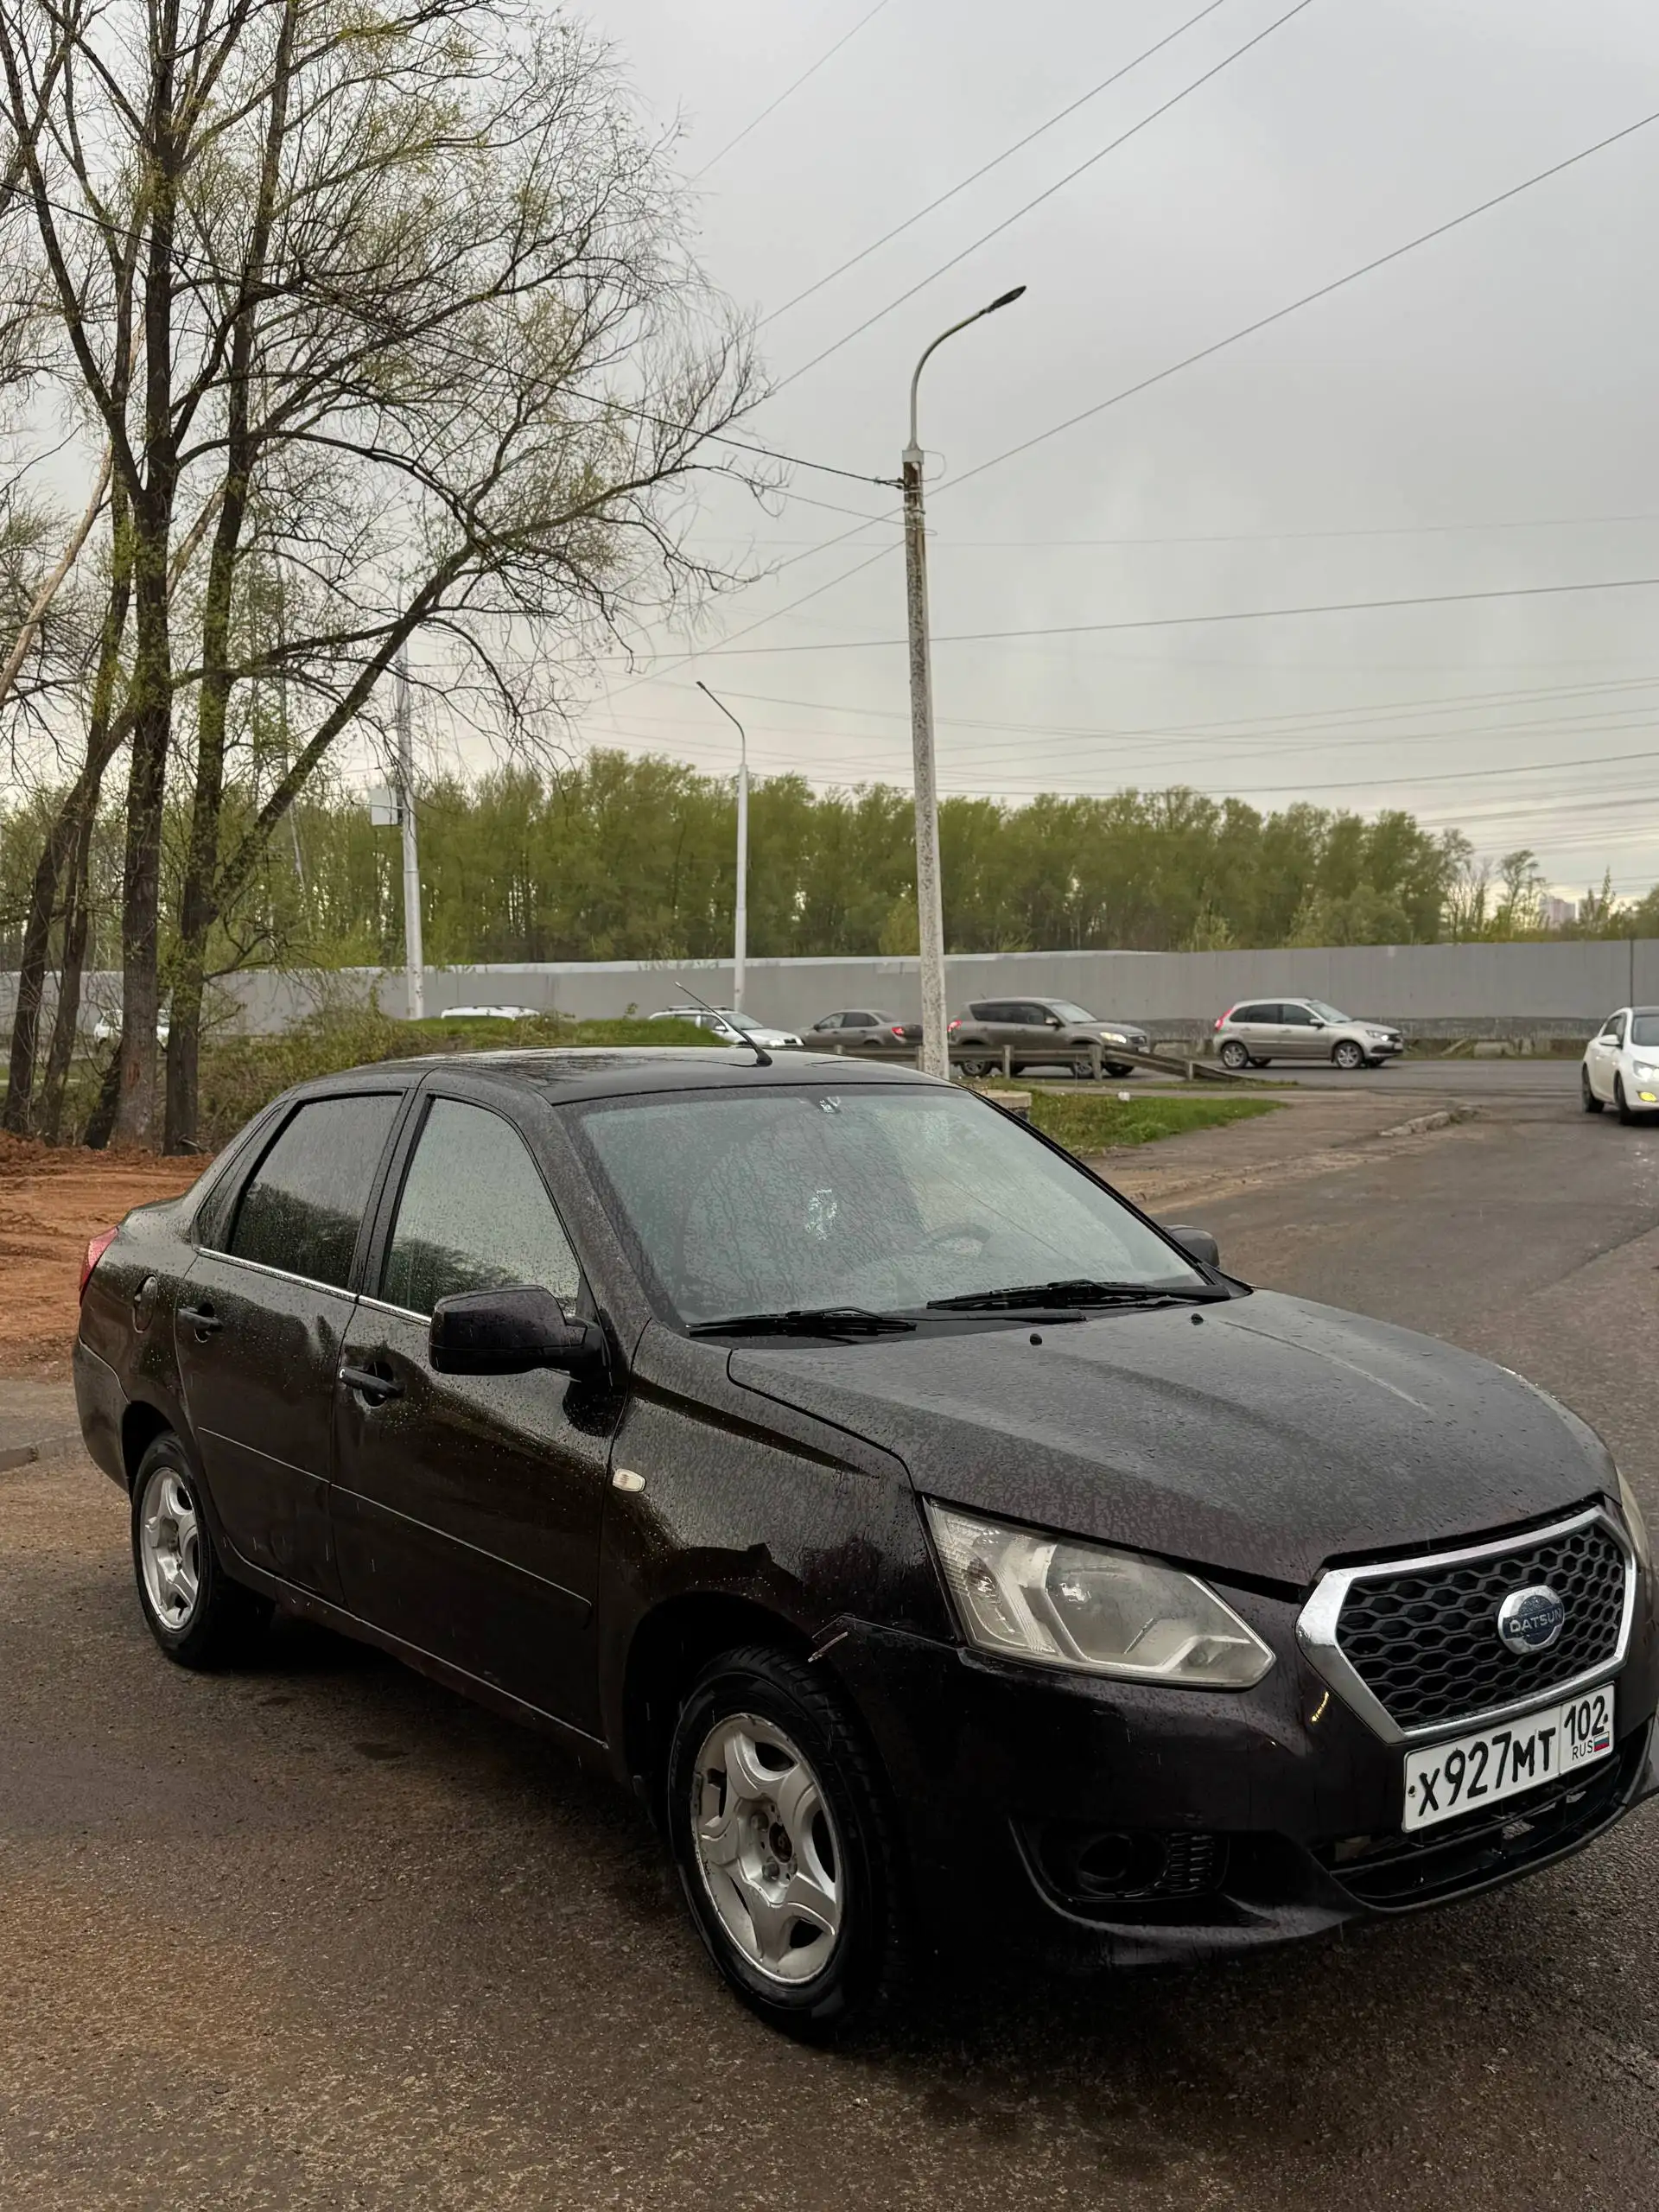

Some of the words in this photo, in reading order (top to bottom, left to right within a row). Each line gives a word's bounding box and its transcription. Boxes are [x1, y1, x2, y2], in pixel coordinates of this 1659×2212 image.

[1510, 1608, 1561, 1633] DATSUN
[1564, 1695, 1605, 1745] 102
[1572, 1740, 1593, 1760] RUS
